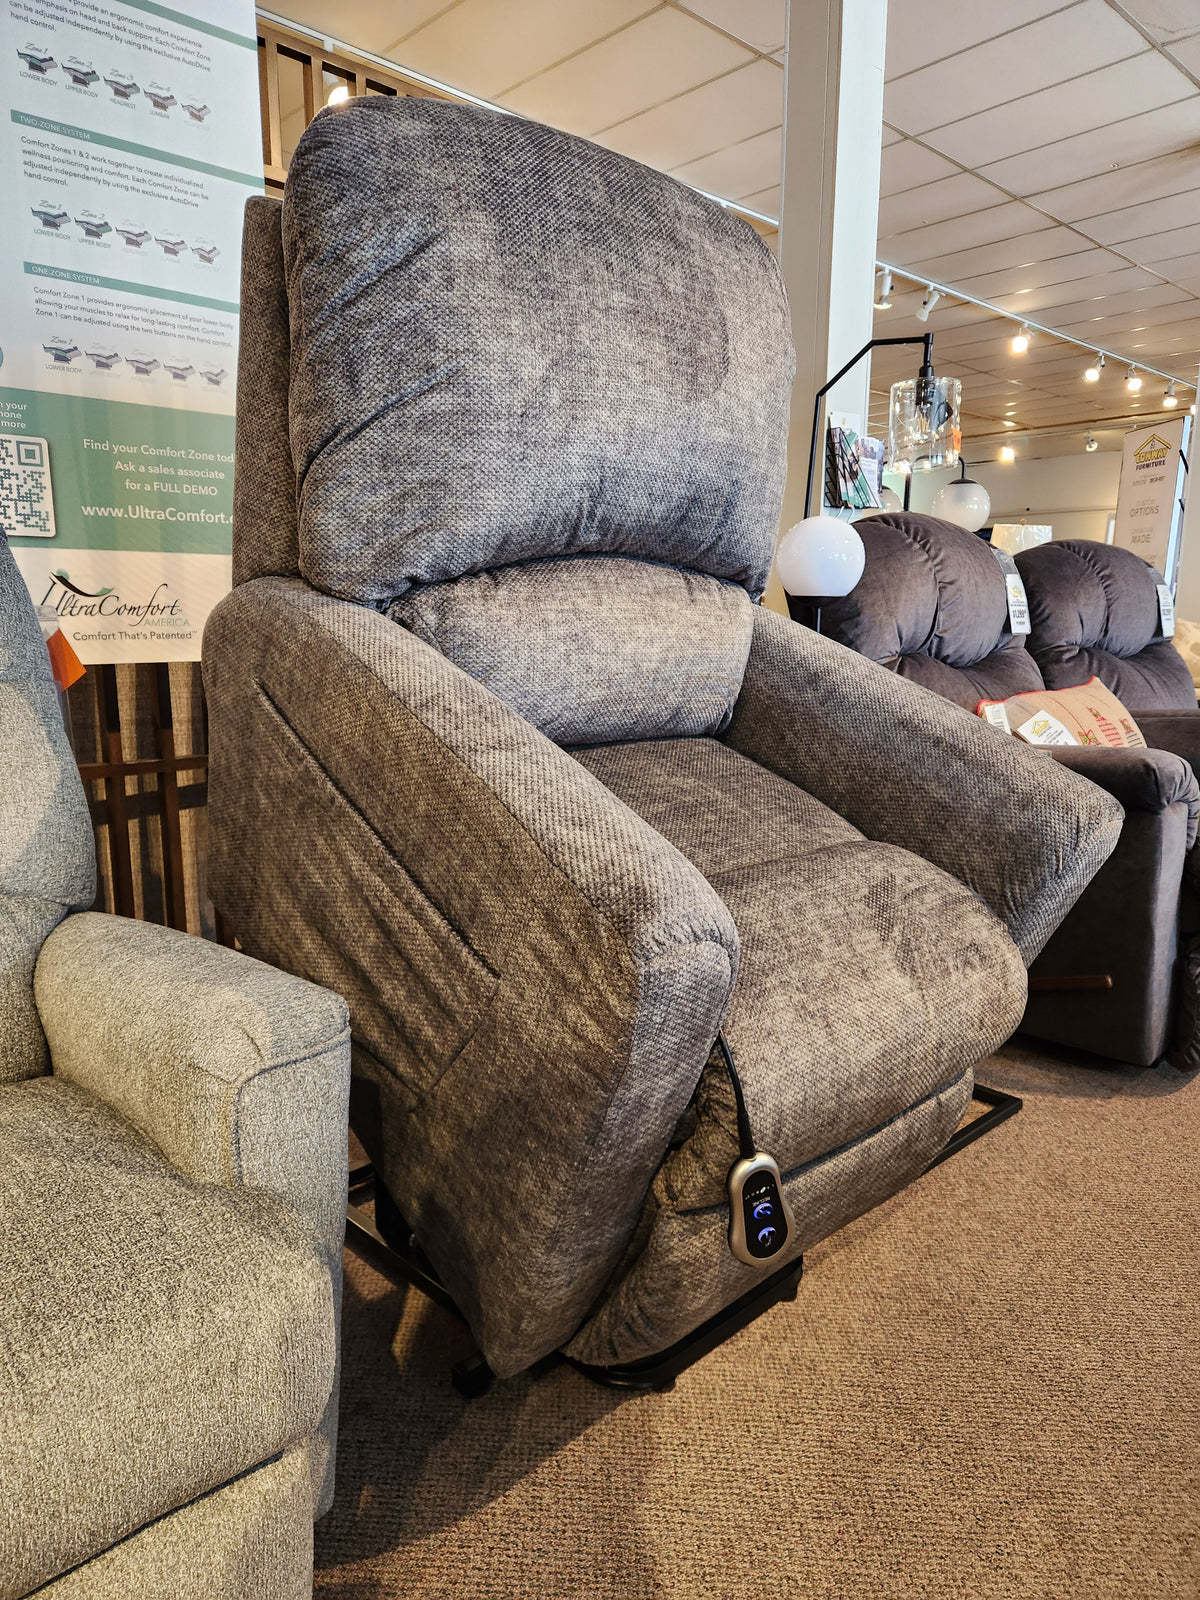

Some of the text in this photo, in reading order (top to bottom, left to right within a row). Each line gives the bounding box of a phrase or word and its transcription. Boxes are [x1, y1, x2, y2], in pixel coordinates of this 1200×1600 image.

[10, 10, 56, 32] hand control.
[73, 0, 99, 12] provide
[110, 12, 144, 28] ergonomic
[145, 24, 169, 37] comfort
[170, 33, 202, 48] experience
[9, 0, 211, 72] can be adjusted independently by using the exclusive AutoDrive
[69, 8, 78, 16] on
[80, 11, 96, 22] head
[98, 17, 110, 27] and
[112, 22, 127, 32] back
[155, 37, 170, 47] Each
[171, 42, 196, 57] Comfort
[196, 51, 211, 62] Zone
[20, 115, 90, 140] TWO-ZONE SYSTEM
[20, 136, 50, 150] Comfort
[51, 144, 72, 154] Zones
[90, 154, 107, 163] work
[108, 159, 136, 170] together
[144, 168, 163, 178] create
[164, 173, 204, 189] individualized
[22, 148, 51, 161] wellness
[52, 156, 90, 171] positioning
[90, 165, 103, 174] and
[132, 175, 147, 184] Each
[148, 179, 173, 191] Comfort
[174, 186, 189, 196] Zone
[190, 190, 200, 198] can
[22, 160, 199, 208] adjusted independently by using the exclusive AutoDrive
[24, 170, 68, 187] hand control.
[32, 265, 100, 284] ONE-ZONE SYSTEM
[34, 286, 62, 298] Comfort
[62, 292, 80, 300] Zone
[86, 296, 114, 307] provides
[116, 303, 149, 314] ergonomic
[150, 307, 181, 320] placement
[202, 317, 219, 326] lower
[220, 321, 234, 330] body
[34, 298, 62, 310] allowing
[64, 303, 79, 311] your
[80, 306, 106, 316] muscles
[106, 310, 114, 318] to
[114, 312, 130, 320] relax
[130, 314, 140, 322] for
[140, 316, 176, 329] long-lasting
[202, 327, 225, 338] Comfort
[35, 308, 53, 317] Zone
[73, 314, 82, 322] be
[84, 317, 111, 328] adjusted
[112, 322, 129, 332] using
[130, 324, 140, 332] the
[154, 328, 176, 338] buttons
[186, 334, 196, 342] the
[196, 336, 212, 344] hand
[5, 402, 28, 411] your
[1, 420, 26, 429] more
[83, 438, 234, 463] Find your Comfort Zone tod
[1135, 448, 1168, 464] CONWAY
[115, 460, 225, 480] Ask a sales associate
[1136, 459, 1166, 471] FURNITURE
[125, 479, 218, 496] for a FULL DEMO
[1130, 505, 1160, 518] OPTIONS
[1131, 534, 1152, 544] MADE
[143, 618, 191, 627] AMERICA
[72, 631, 116, 641] Comfort
[118, 631, 148, 640] That's
